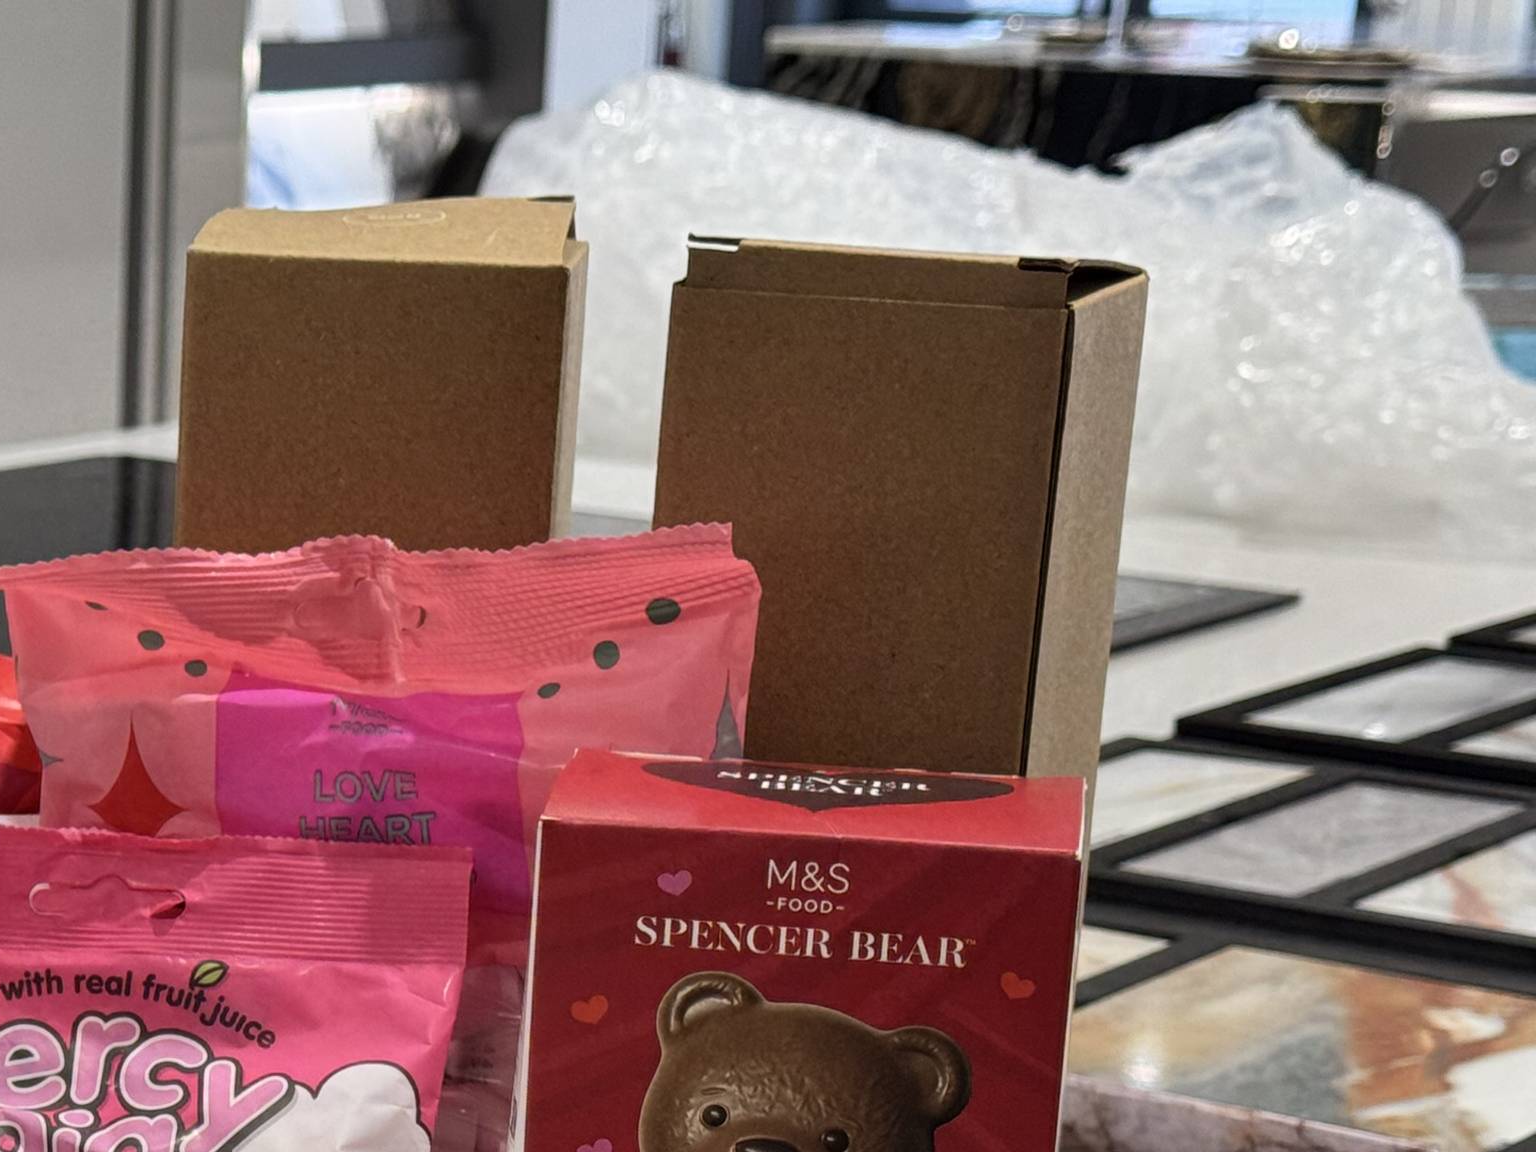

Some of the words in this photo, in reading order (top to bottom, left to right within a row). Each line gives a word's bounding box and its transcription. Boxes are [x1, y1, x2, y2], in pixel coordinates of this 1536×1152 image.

[312, 768, 418, 804] LOVE
[298, 809, 438, 846] HEART
[767, 859, 851, 895] M&S
[777, 897, 833, 914] FOOD
[634, 915, 833, 959] SPENCER
[848, 930, 967, 969] BEAR
[0, 968, 64, 1002] with
[73, 970, 133, 998] real
[142, 974, 208, 1013] fruit
[199, 996, 277, 1050] juice
